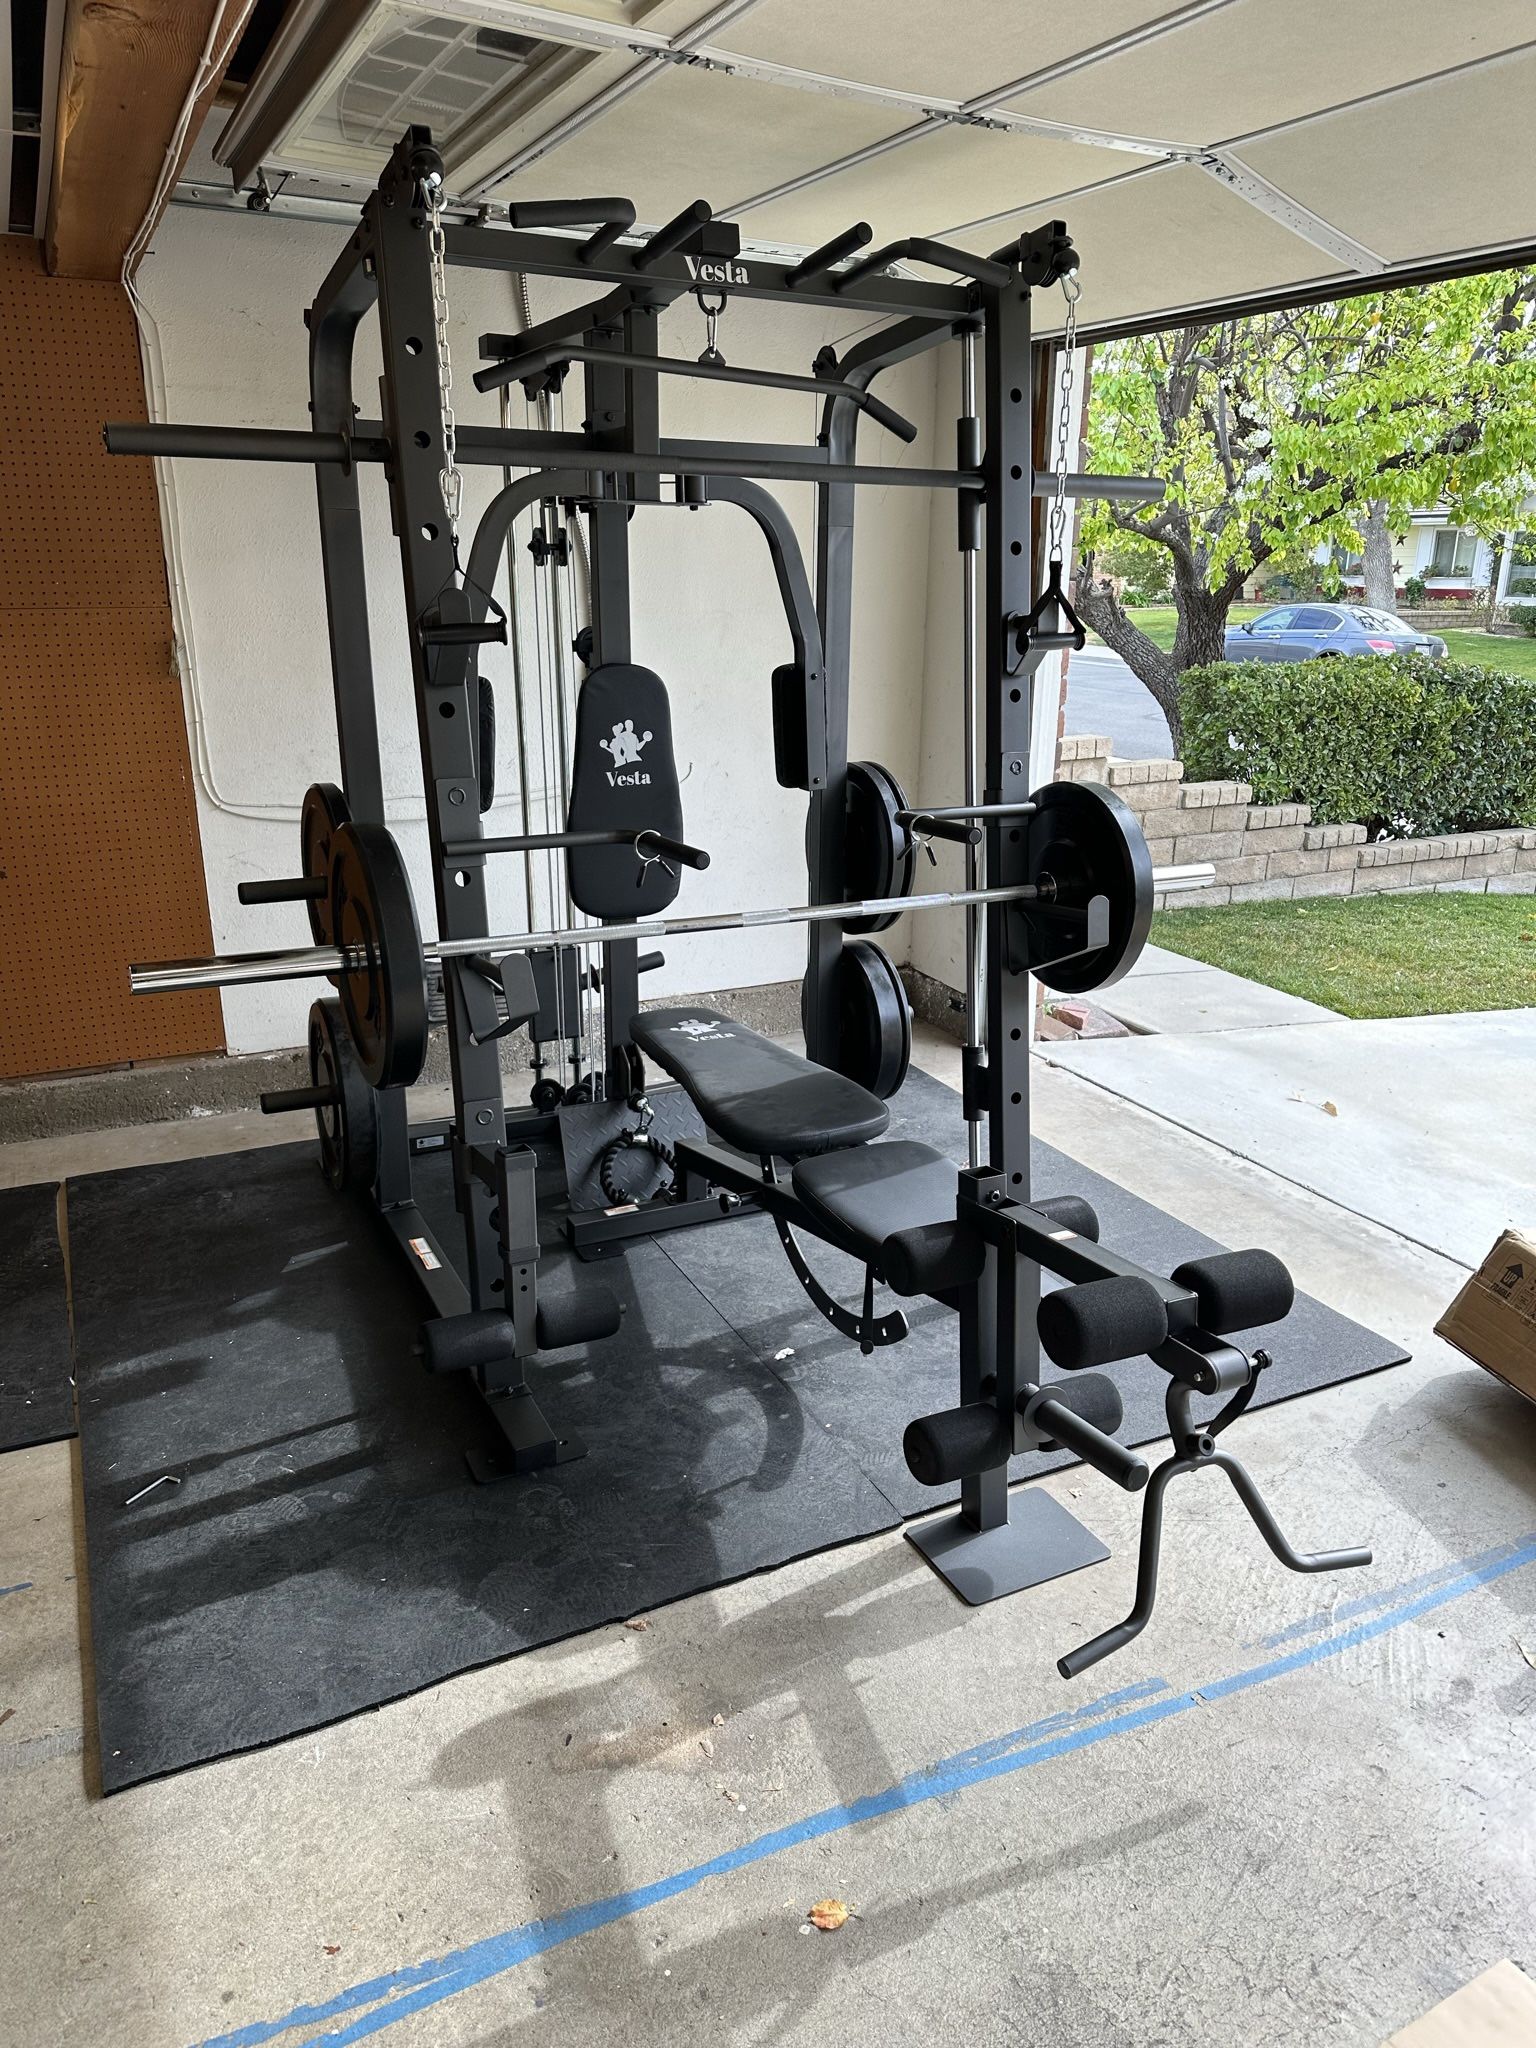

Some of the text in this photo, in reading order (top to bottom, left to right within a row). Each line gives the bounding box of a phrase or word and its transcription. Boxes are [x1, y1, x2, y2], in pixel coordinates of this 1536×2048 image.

[683, 255, 750, 284] Vesta
[605, 770, 651, 787] Vesta
[1503, 1270, 1517, 1285] UP
